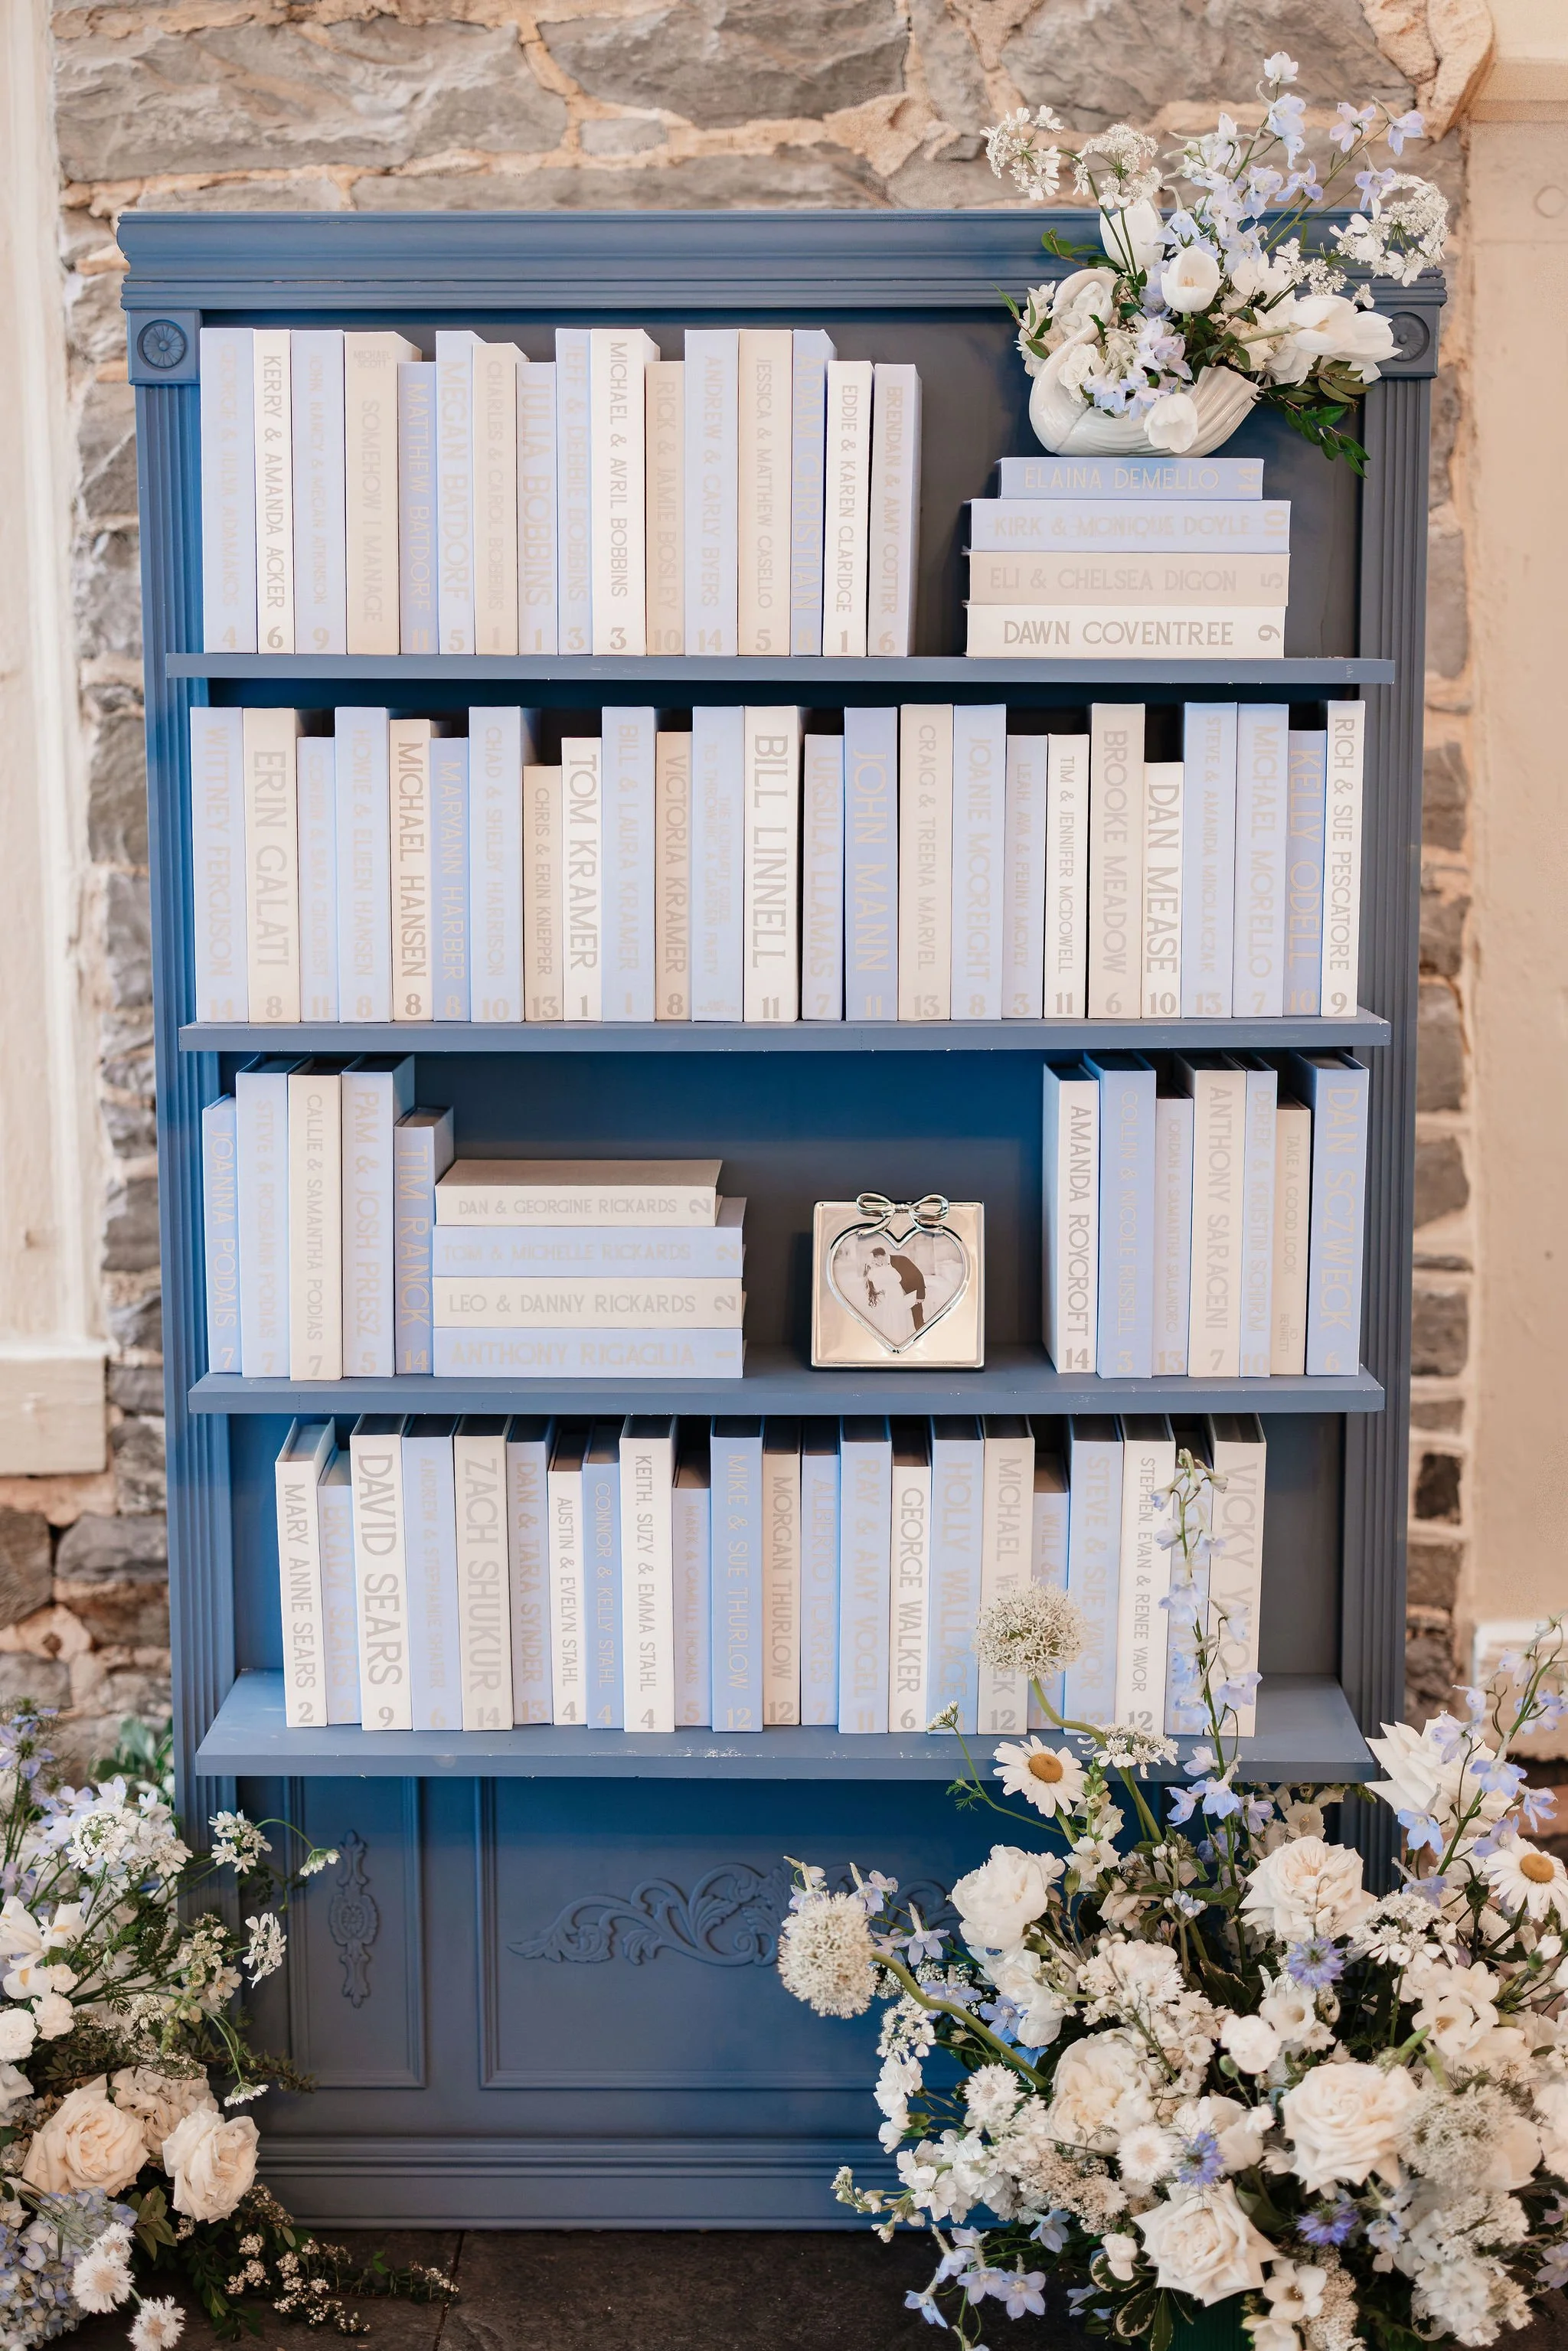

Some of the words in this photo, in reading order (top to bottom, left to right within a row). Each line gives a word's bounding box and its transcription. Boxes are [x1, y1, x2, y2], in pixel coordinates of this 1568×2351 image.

[263, 354, 283, 419] KERRY
[609, 341, 628, 425] MICHAEL
[756, 357, 773, 420] JESSICA
[840, 384, 859, 433] EDDIE
[263, 426, 283, 445] &
[361, 399, 381, 510] SOMEHOW
[609, 433, 628, 448] &
[756, 427, 773, 440] &
[839, 437, 858, 453] &
[264, 451, 284, 537] AMANDA
[609, 457, 628, 509] AVRIL
[756, 448, 773, 527] MATTHEW
[838, 459, 857, 519] KAREN
[1024, 469, 1103, 491] ELAINA
[1112, 468, 1220, 492] DEMELLO
[1236, 465, 1261, 492] 14
[266, 544, 286, 609] ACKER
[363, 534, 383, 623] MANAGE
[609, 517, 629, 597] BOBBINS
[756, 534, 773, 609] CASELLO
[835, 524, 854, 613] CLARIDGE
[990, 567, 1020, 590] ELI
[1030, 568, 1047, 590] &
[1057, 568, 1154, 591] CHELSEA
[1165, 570, 1237, 592] DIGON
[1261, 571, 1284, 589] 5
[267, 625, 284, 649] 6
[609, 626, 628, 650] 3
[755, 629, 773, 651] 5
[839, 629, 849, 652] 1
[1003, 619, 1071, 645] DAWN
[1081, 620, 1234, 646] COVENTREE
[1257, 623, 1281, 642] 9
[918, 724, 937, 786] CRAIG
[1334, 718, 1355, 769] RICH
[253, 749, 287, 828] ERIN
[569, 754, 598, 825] TOM
[753, 733, 789, 809] BILL
[1059, 756, 1076, 784] TIM
[1102, 730, 1129, 844] BROOKE
[1334, 778, 1354, 795] &
[397, 742, 424, 862] MICHAEL
[532, 787, 550, 837] CHRIS
[663, 753, 688, 865] VICTORIA
[851, 749, 887, 846] JOHN
[918, 793, 936, 808] &
[1059, 789, 1075, 803] &
[1144, 782, 1180, 851] DAN
[1058, 810, 1075, 878] JENNIFER
[1331, 804, 1353, 841] SUE
[532, 842, 551, 856] &
[917, 817, 936, 887] TREENA
[255, 844, 289, 967] GALATI
[532, 863, 551, 900] ERIN
[569, 838, 598, 971] KRAMER
[752, 824, 788, 968] LINNELL
[399, 874, 426, 978] HANSEN
[663, 876, 689, 975] KRAMER
[849, 860, 888, 973] MANN
[917, 896, 936, 971] MARVEL
[1057, 885, 1074, 975] MCDOWELL
[1102, 854, 1128, 975] MEADOW
[1144, 865, 1182, 974] MEASE
[1329, 851, 1352, 971] PESCATORE
[532, 906, 553, 976] KNEPPER
[266, 995, 284, 1018] 8
[404, 992, 423, 1015] 8
[531, 996, 560, 1017] 13
[580, 994, 590, 1017] 1
[666, 992, 684, 1016] 8
[762, 996, 780, 1018] 11
[864, 994, 884, 1017] 11
[913, 994, 941, 1017] 13
[1054, 991, 1073, 1014] 11
[1105, 991, 1123, 1014] 6
[1149, 991, 1178, 1014] 10
[1330, 991, 1348, 1014] 9
[305, 1093, 323, 1152] CALLIE
[1207, 1086, 1233, 1203] ANTHONY
[306, 1158, 324, 1172] &
[396, 1146, 430, 1200] TIM
[1069, 1104, 1092, 1203] AMANDA
[1285, 1134, 1302, 1166] TAKE
[1285, 1171, 1300, 1182] A
[306, 1178, 323, 1271] SAMANTHA
[458, 1199, 489, 1216] DAN
[495, 1199, 507, 1215] &
[513, 1198, 593, 1214] GEORGINE
[597, 1198, 678, 1213] RICKARDS
[688, 1197, 711, 1215] 2
[1283, 1186, 1299, 1231] GOOD
[397, 1216, 431, 1327] RANCK
[1067, 1213, 1090, 1337] ROYCROFT
[1205, 1213, 1230, 1330] SARACENI
[1282, 1236, 1298, 1276] LOOK
[306, 1278, 323, 1341] PODIAS
[449, 1294, 488, 1313] LEO
[495, 1294, 511, 1313] &
[520, 1294, 585, 1313] DANNY
[593, 1294, 697, 1313] RICKARDS
[714, 1295, 737, 1312] 2
[308, 1355, 323, 1377] 7
[403, 1349, 430, 1371] 14
[1065, 1348, 1089, 1369] 14
[1209, 1348, 1226, 1372] 7
[464, 1458, 498, 1547] ZACH
[726, 1455, 747, 1504] MIKE
[283, 1483, 309, 1546] MARY
[358, 1454, 397, 1557] DAVID
[557, 1497, 575, 1549] AUSTIN
[726, 1512, 747, 1532] &
[770, 1476, 794, 1570] MORGAN
[996, 1458, 1022, 1562] MICHAEL
[1220, 1461, 1258, 1569] VICKY
[635, 1513, 655, 1554] SUZY
[895, 1487, 925, 1589] GEORGE
[1136, 1531, 1158, 1569] EVAN
[559, 1556, 575, 1569] &
[637, 1562, 655, 1575] &
[726, 1540, 750, 1579] SUE
[1135, 1573, 1152, 1588] &
[288, 1557, 312, 1614] ANNE
[559, 1576, 577, 1634] EVELYN
[637, 1582, 655, 1634] EMMA
[364, 1573, 403, 1686] SEARS
[467, 1559, 501, 1693] SHUKUR
[725, 1589, 750, 1693] THURLOW
[770, 1580, 793, 1680] THURLOW
[1133, 1592, 1152, 1641] RENEE
[292, 1621, 317, 1689] SEARS
[560, 1638, 579, 1687] STAHL
[639, 1641, 657, 1693] STAHL
[897, 1599, 922, 1694] WALKER
[1131, 1646, 1149, 1693] YAVOR
[298, 1701, 314, 1722] 2
[377, 1706, 395, 1727] 9
[475, 1706, 500, 1727] 14
[563, 1700, 577, 1720] 4
[640, 1709, 655, 1729] 4
[726, 1706, 750, 1730] 12
[768, 1701, 795, 1723] 12
[900, 1708, 917, 1729] 6
[990, 1709, 1016, 1731] 12
